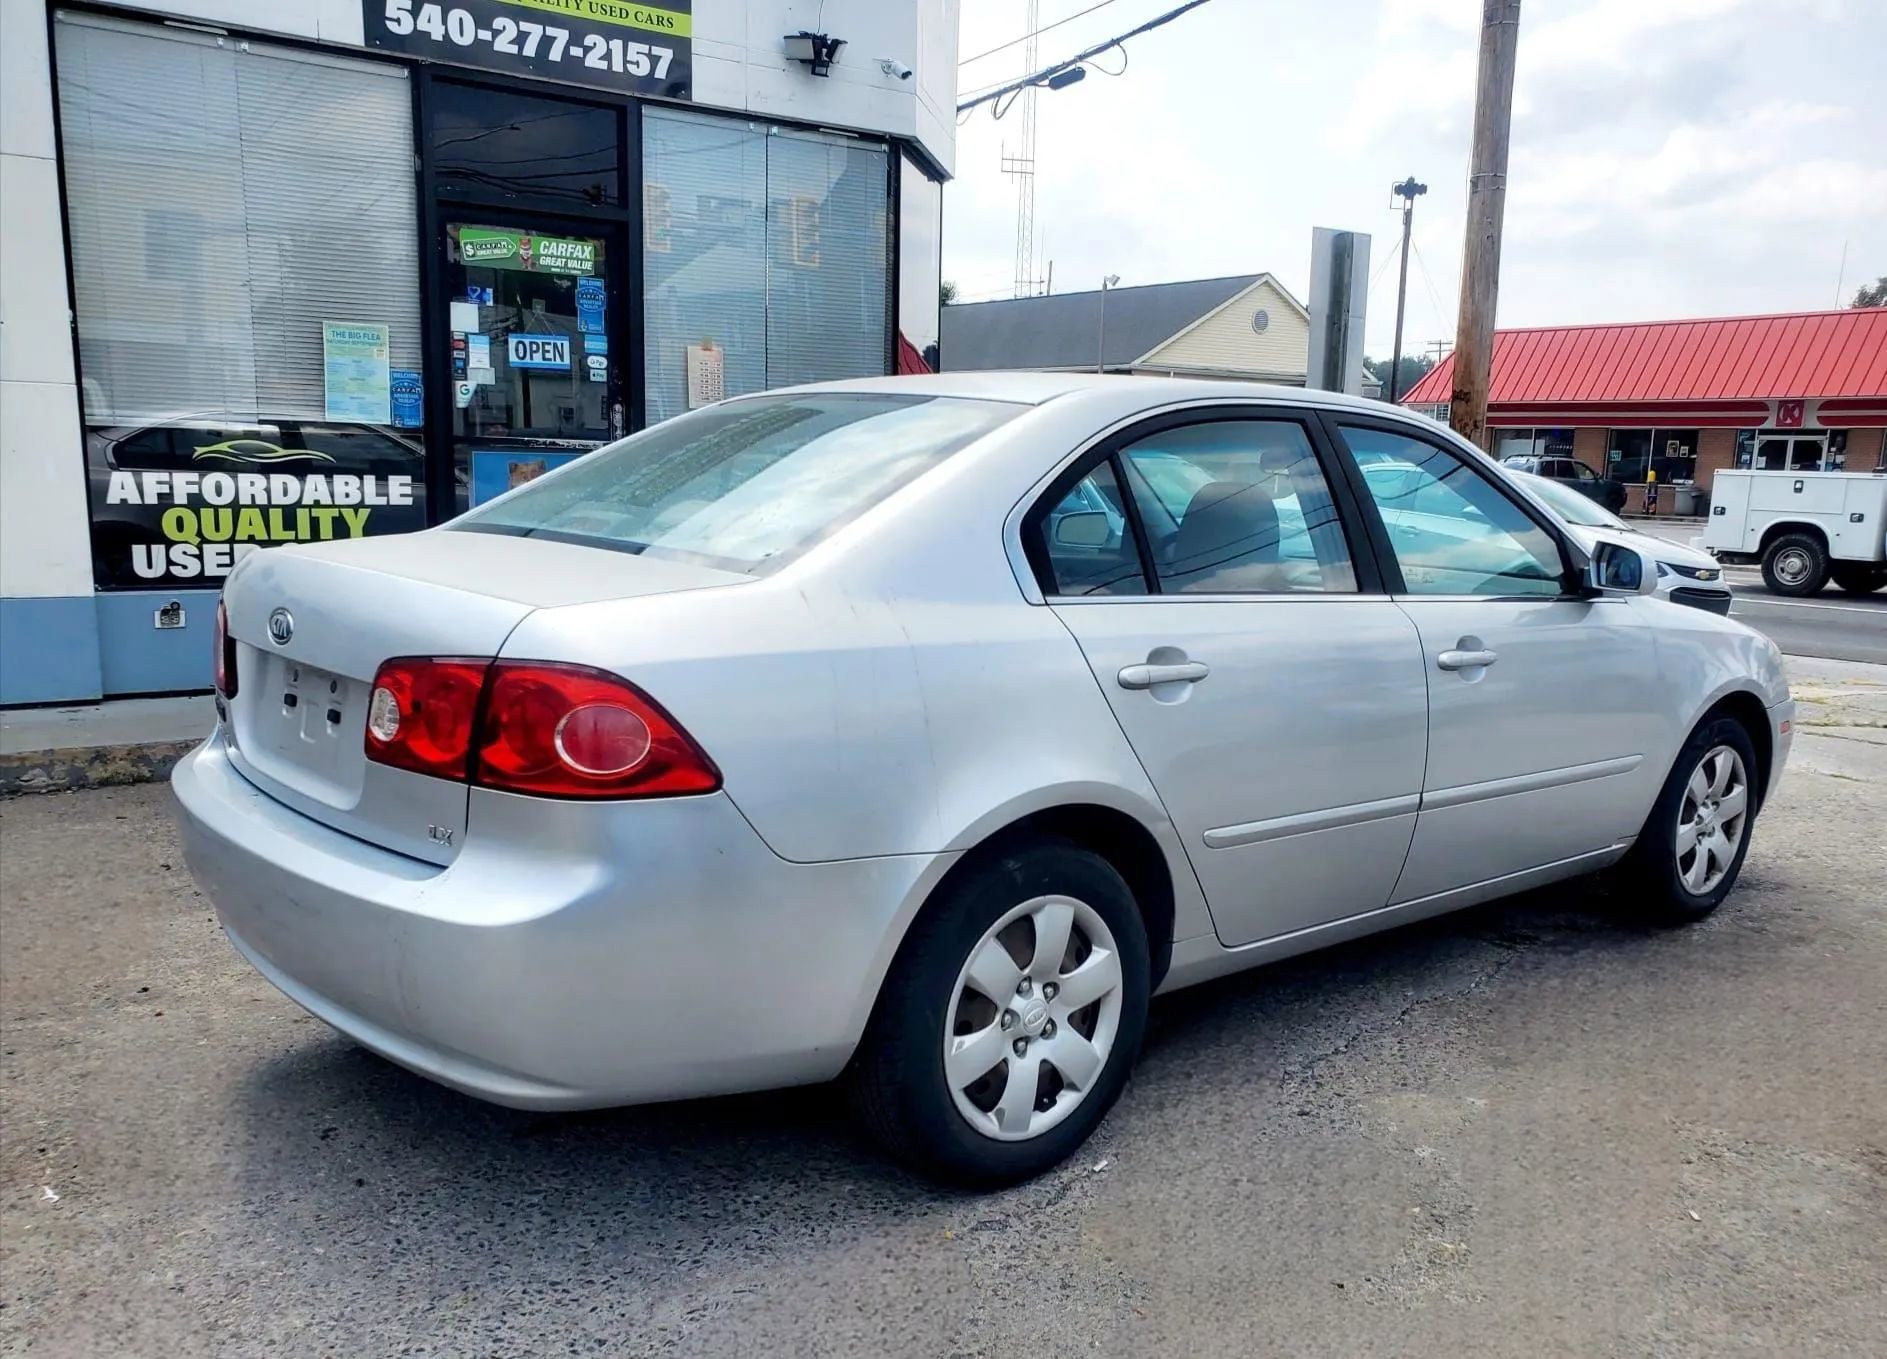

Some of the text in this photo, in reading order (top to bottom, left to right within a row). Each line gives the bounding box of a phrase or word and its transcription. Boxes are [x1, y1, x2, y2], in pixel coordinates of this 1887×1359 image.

[589, 1, 630, 20] USED
[634, 10, 675, 29] CARS
[384, 0, 674, 80] 540-277-2157
[540, 240, 593, 259] CARFAX
[540, 256, 593, 270] GREAT VALUE
[331, 330, 381, 341] THE BIG FLEA
[514, 340, 565, 362] OPEN
[106, 471, 414, 506] AFFORDABLE
[161, 507, 371, 546] QUALITY
[428, 824, 453, 847] LX
